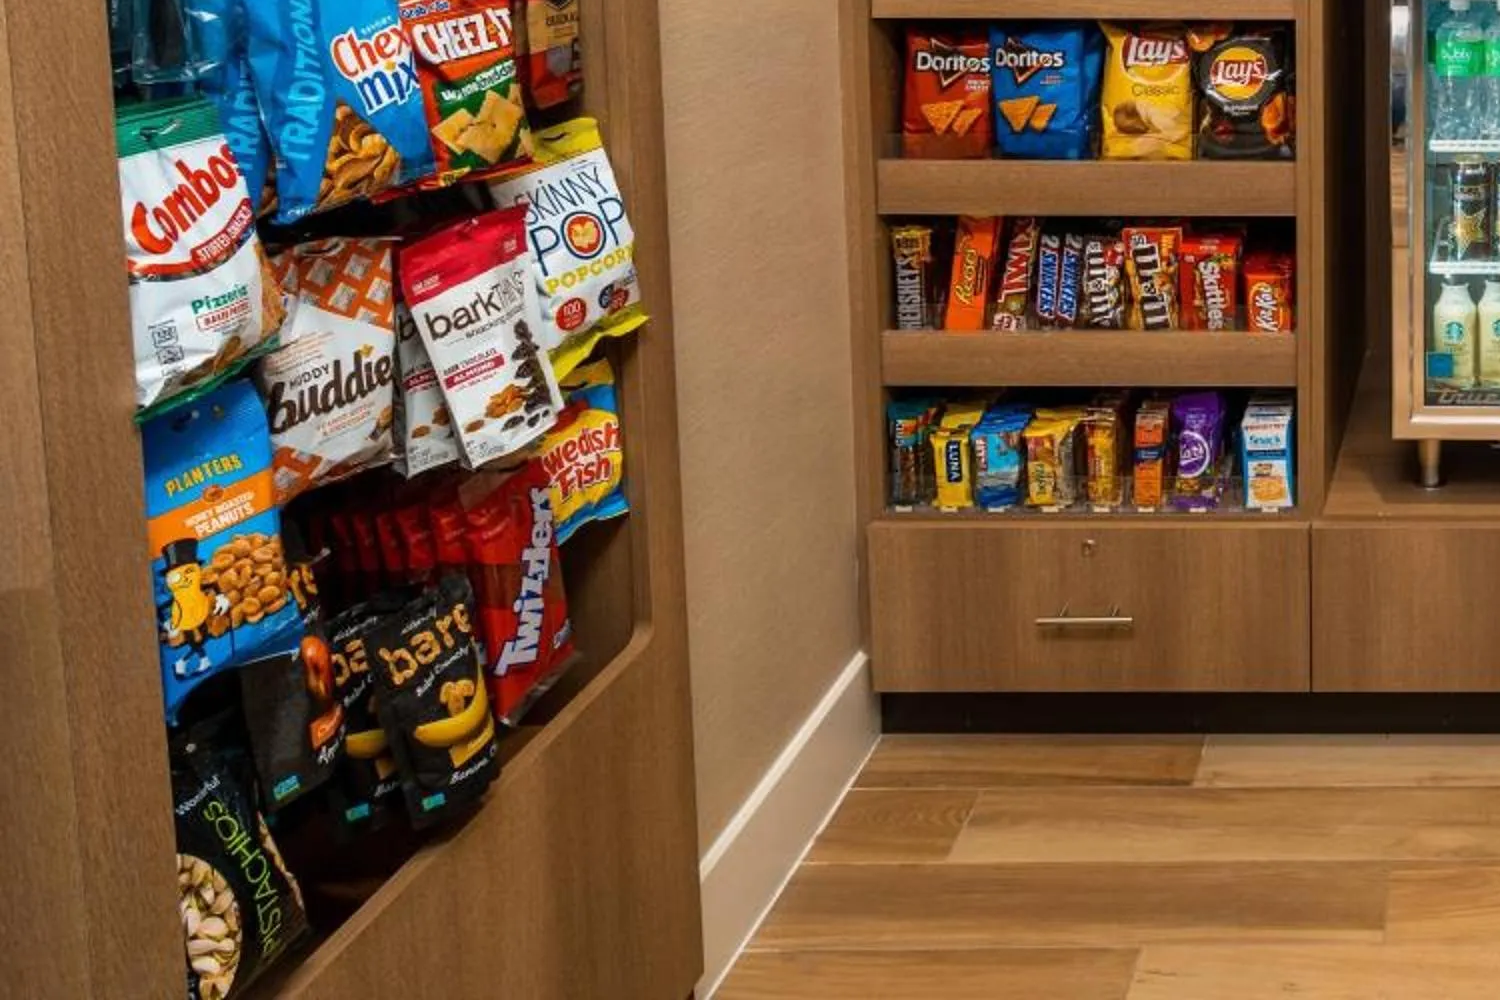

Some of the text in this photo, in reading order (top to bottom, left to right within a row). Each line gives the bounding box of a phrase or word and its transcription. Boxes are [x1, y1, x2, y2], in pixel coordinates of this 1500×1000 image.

[333, 23, 410, 79] Chex
[412, 7, 512, 64] CHEEZ-IT
[916, 51, 991, 72] Doritos
[995, 48, 1064, 68] Doritos
[130, 144, 238, 255] Combos
[529, 197, 625, 277] POP
[544, 245, 636, 294] POPCORN
[896, 255, 921, 329] HERSHEY'S
[998, 230, 1034, 303] TWIX
[1039, 249, 1059, 318] SNICKERS
[1059, 249, 1080, 320] SNICKERS
[1199, 260, 1225, 329] Skittles
[192, 283, 249, 315] Pizzeria
[425, 287, 500, 341] bark
[267, 350, 394, 434] buddie
[165, 454, 243, 498] PLANTERS
[559, 453, 611, 501] Fish
[948, 443, 961, 481] LUNA
[194, 502, 255, 538] PEANUTS
[494, 487, 555, 676] Twizzlers
[379, 602, 473, 687] bare
